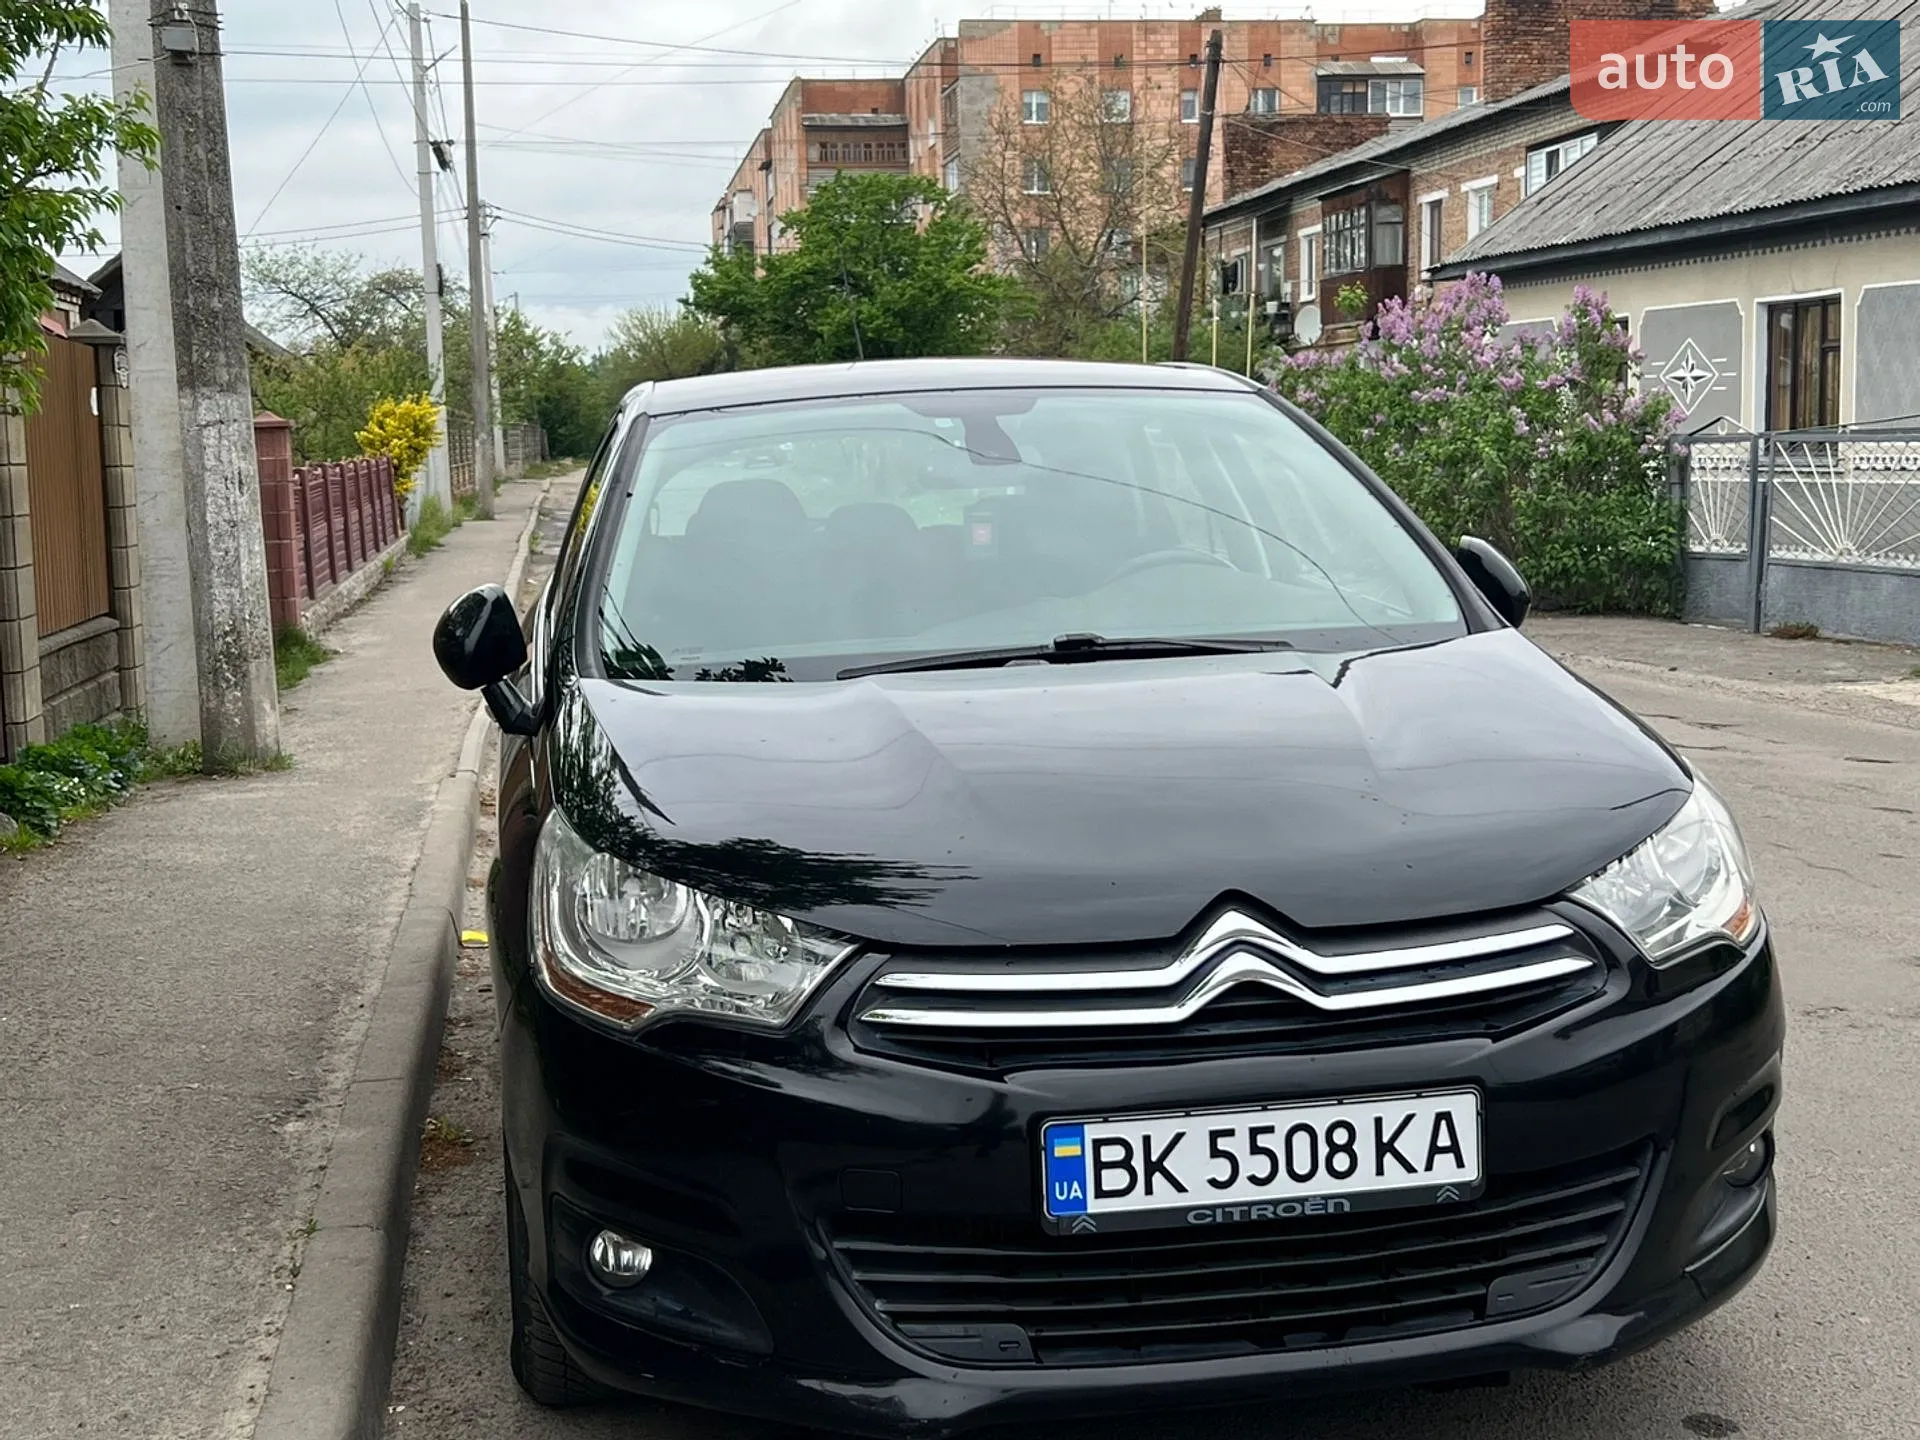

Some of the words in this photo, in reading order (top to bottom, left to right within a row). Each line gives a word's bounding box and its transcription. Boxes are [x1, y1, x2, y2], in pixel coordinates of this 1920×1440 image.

[1091, 1131, 1190, 1200] BK
[1206, 1119, 1359, 1190] 5508
[1374, 1110, 1466, 1177] KA
[1055, 1181, 1084, 1201] UA
